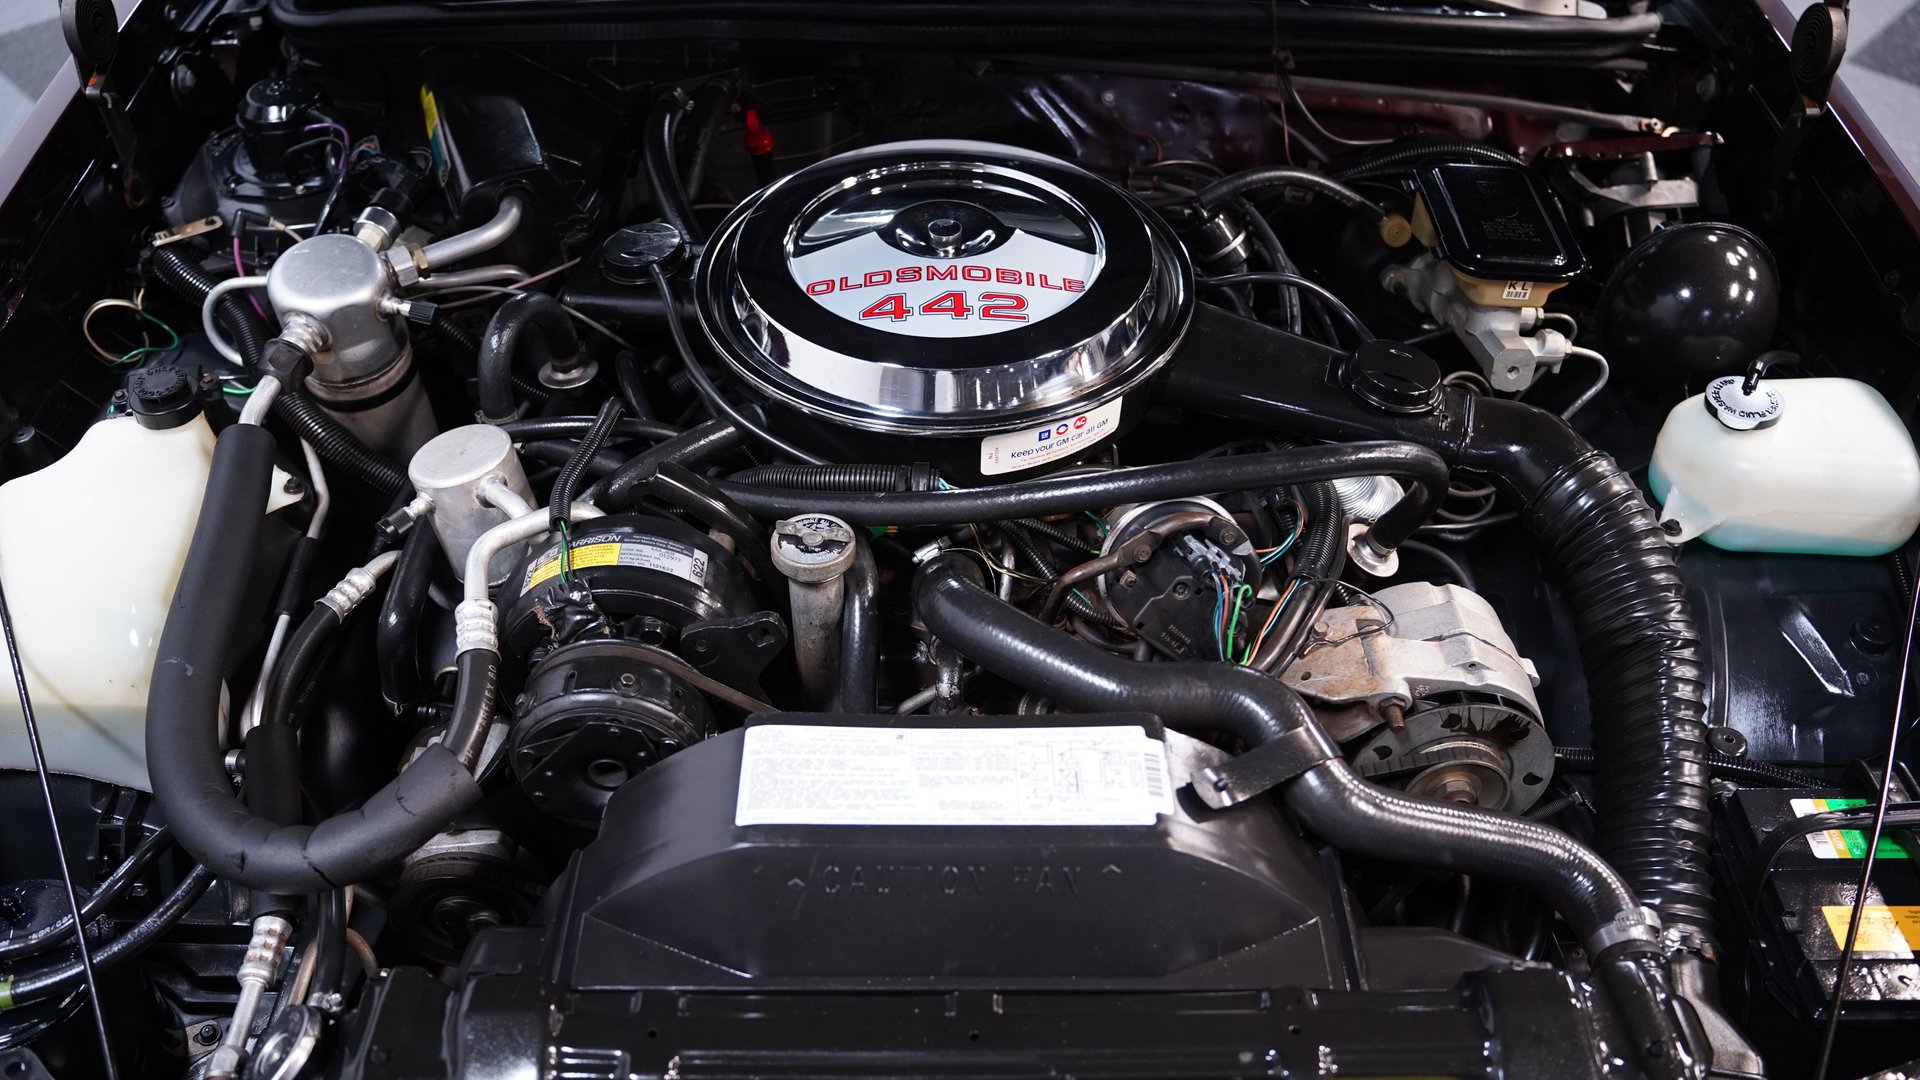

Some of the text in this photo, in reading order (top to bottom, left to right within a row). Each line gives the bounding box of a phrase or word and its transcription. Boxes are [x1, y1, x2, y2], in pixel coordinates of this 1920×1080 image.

[806, 265, 1086, 296] OLDSMOBILE
[859, 290, 1030, 322] 442
[1010, 447, 1034, 459] Keep
[1035, 442, 1054, 455] your
[1056, 437, 1070, 447] GM
[1071, 431, 1085, 442] car
[1085, 425, 1096, 436] all
[1097, 418, 1109, 429] GM
[569, 534, 621, 548] ARRISON
[692, 557, 706, 578] 622
[823, 866, 1082, 895] CAUTION FAN
